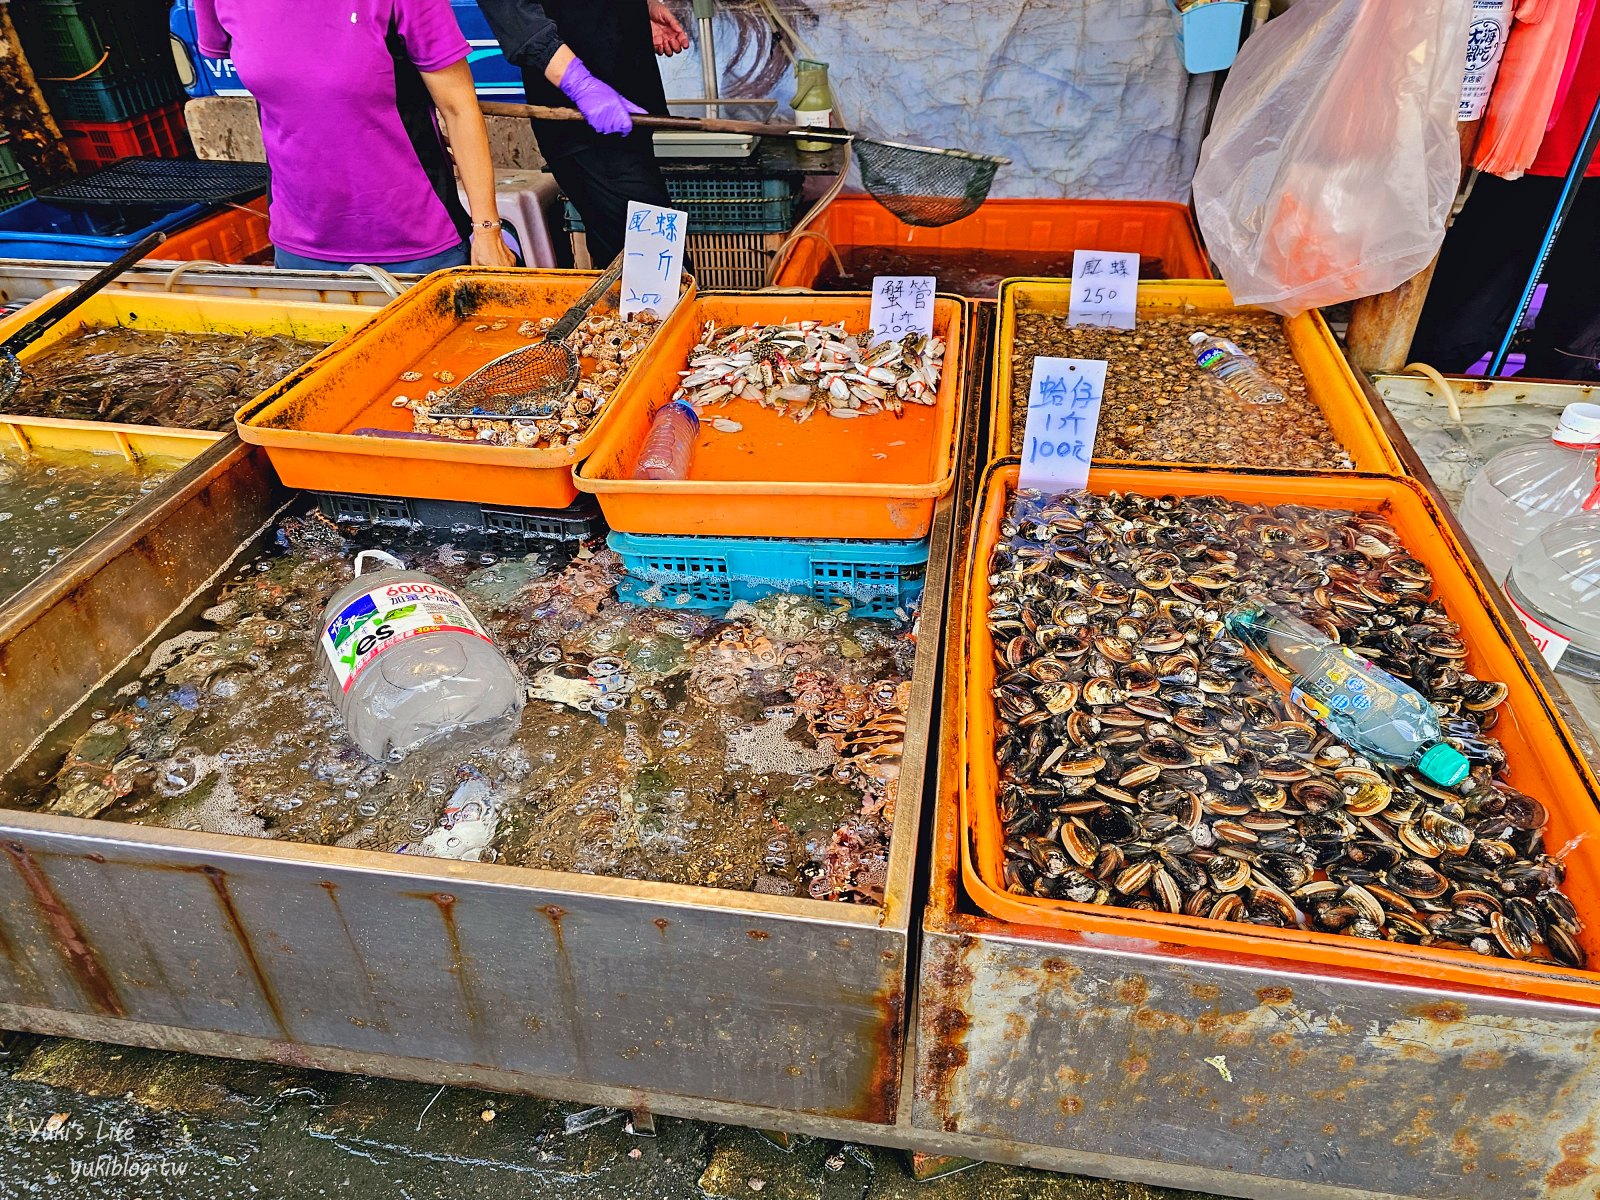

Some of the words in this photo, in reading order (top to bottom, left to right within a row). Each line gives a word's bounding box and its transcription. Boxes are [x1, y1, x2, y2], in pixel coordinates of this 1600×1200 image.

[1082, 287, 1118, 304] 250
[1029, 436, 1090, 464] 100元
[386, 584, 436, 597] 6000
